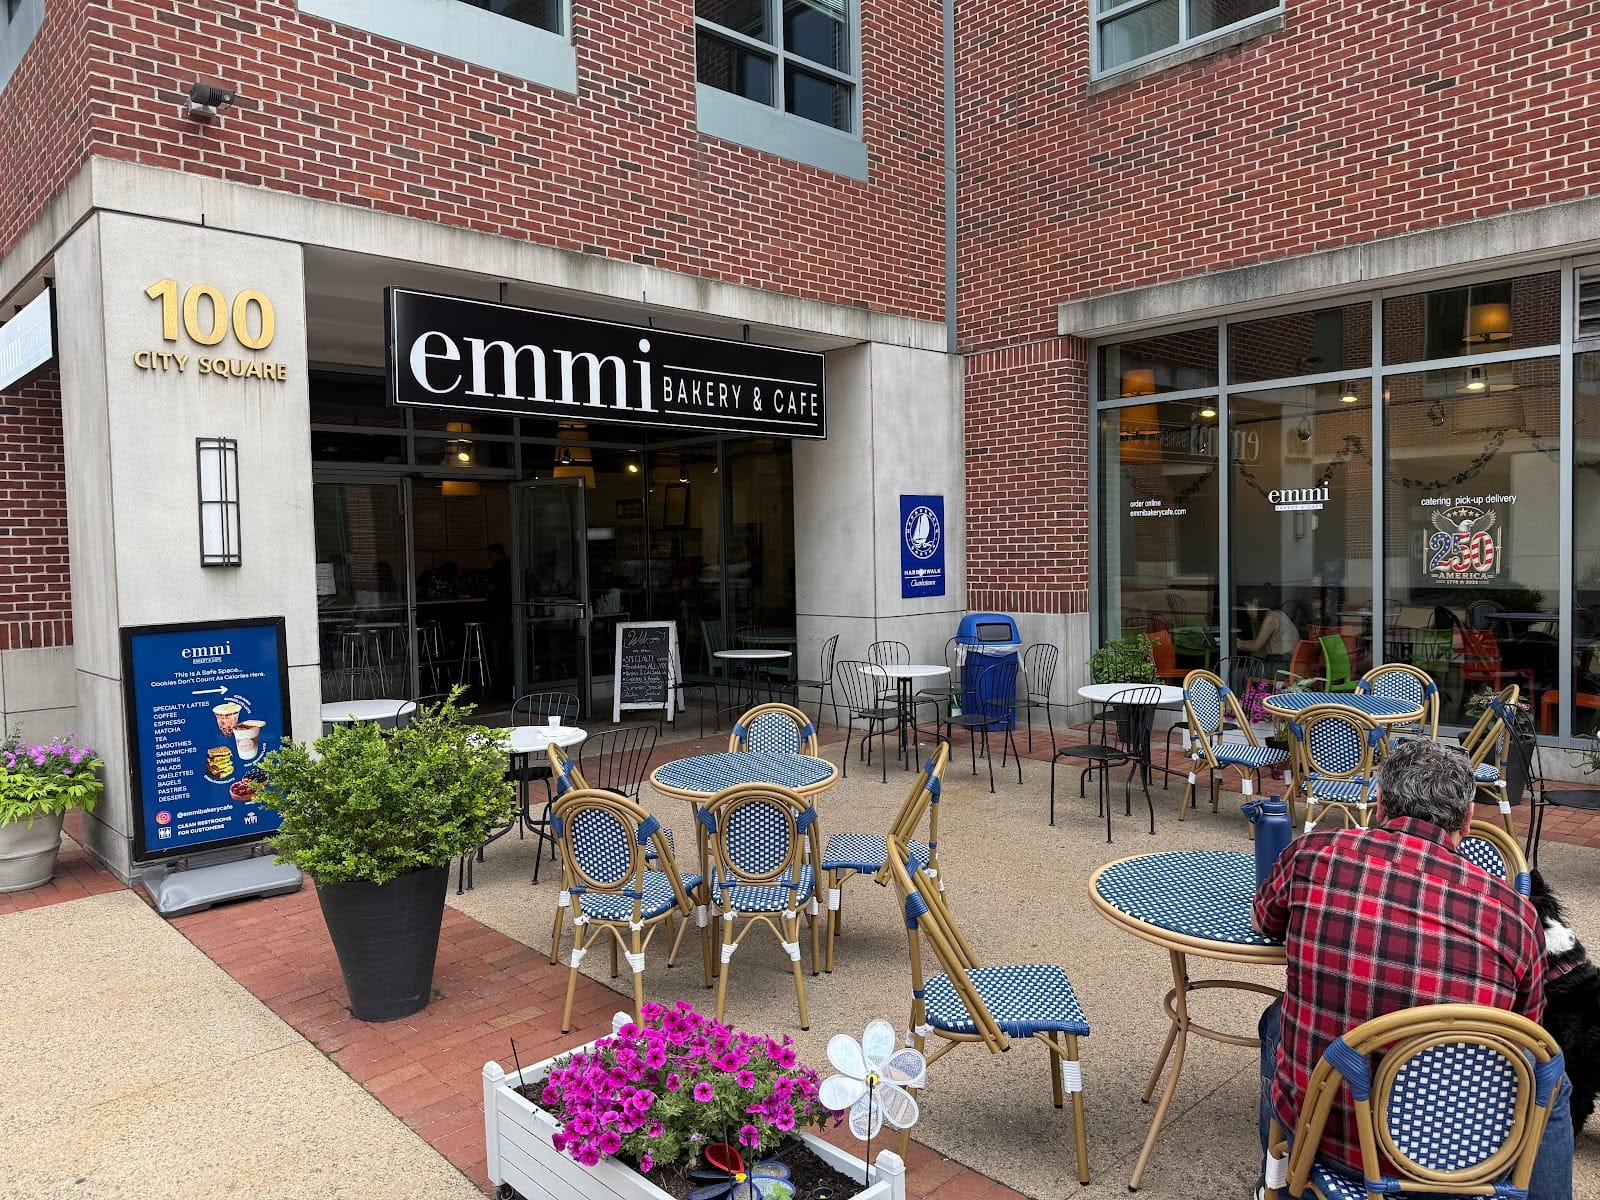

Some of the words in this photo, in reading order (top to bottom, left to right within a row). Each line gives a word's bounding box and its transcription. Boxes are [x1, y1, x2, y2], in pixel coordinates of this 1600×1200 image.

[145, 278, 276, 351] 100
[134, 350, 189, 373] CITY
[199, 356, 288, 382] SQUARE
[409, 330, 659, 413] emmi
[663, 376, 741, 409] BAKERY
[753, 389, 763, 412] &
[774, 389, 818, 416] CAFE
[1268, 480, 1331, 504] emmi
[1129, 500, 1144, 508] order
[1144, 499, 1161, 507] online
[1421, 497, 1451, 506] catering
[1455, 495, 1484, 506] pick-up
[1485, 494, 1517, 504] delivery
[1129, 507, 1187, 518] emmibakerycafe.com
[1429, 531, 1494, 572] 250
[1438, 572, 1488, 580] AMERICA
[181, 640, 232, 659] emmi
[224, 673, 249, 681] Calories
[153, 703, 185, 713] SPECIALTY
[186, 701, 210, 709] LATTES
[153, 712, 178, 720] COFFEE
[154, 718, 186, 728] ESPRESSO
[154, 726, 181, 735] MATCHA
[156, 740, 192, 750] SMOOTHIES
[156, 747, 197, 758] SANDWICHES
[156, 757, 181, 765] PANINIS
[156, 764, 182, 773] SALADS
[157, 770, 194, 780] OMELETTES
[157, 779, 182, 787] BAGELS
[158, 786, 187, 795] PASTRIES
[158, 792, 191, 803] DESSERTS
[176, 804, 234, 819] @emmibakerycafe
[177, 820, 197, 830] CLEAN
[197, 816, 232, 827] RESTROOMS
[177, 828, 190, 836] FOR
[190, 823, 225, 834] CUSTOMERS
